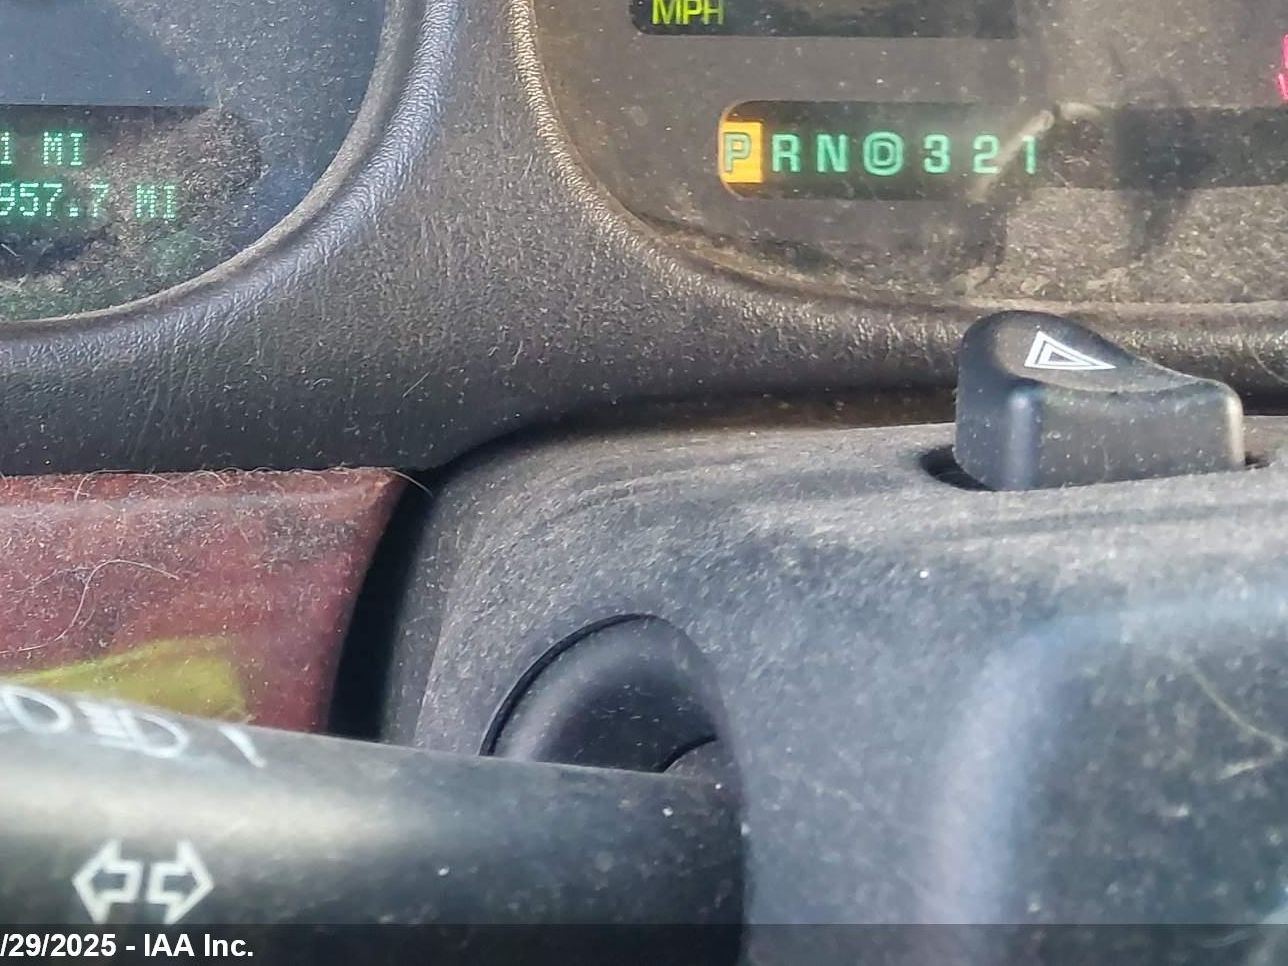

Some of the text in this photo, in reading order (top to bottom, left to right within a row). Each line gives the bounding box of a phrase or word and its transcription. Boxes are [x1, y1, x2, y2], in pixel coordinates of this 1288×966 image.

[43, 131, 84, 166] MI
[725, 134, 751, 173] P
[771, 134, 799, 173] R
[816, 135, 847, 173] N
[924, 134, 949, 173] 3
[973, 135, 999, 174] 2
[1022, 136, 1037, 174] 1
[135, 184, 176, 219] MI
